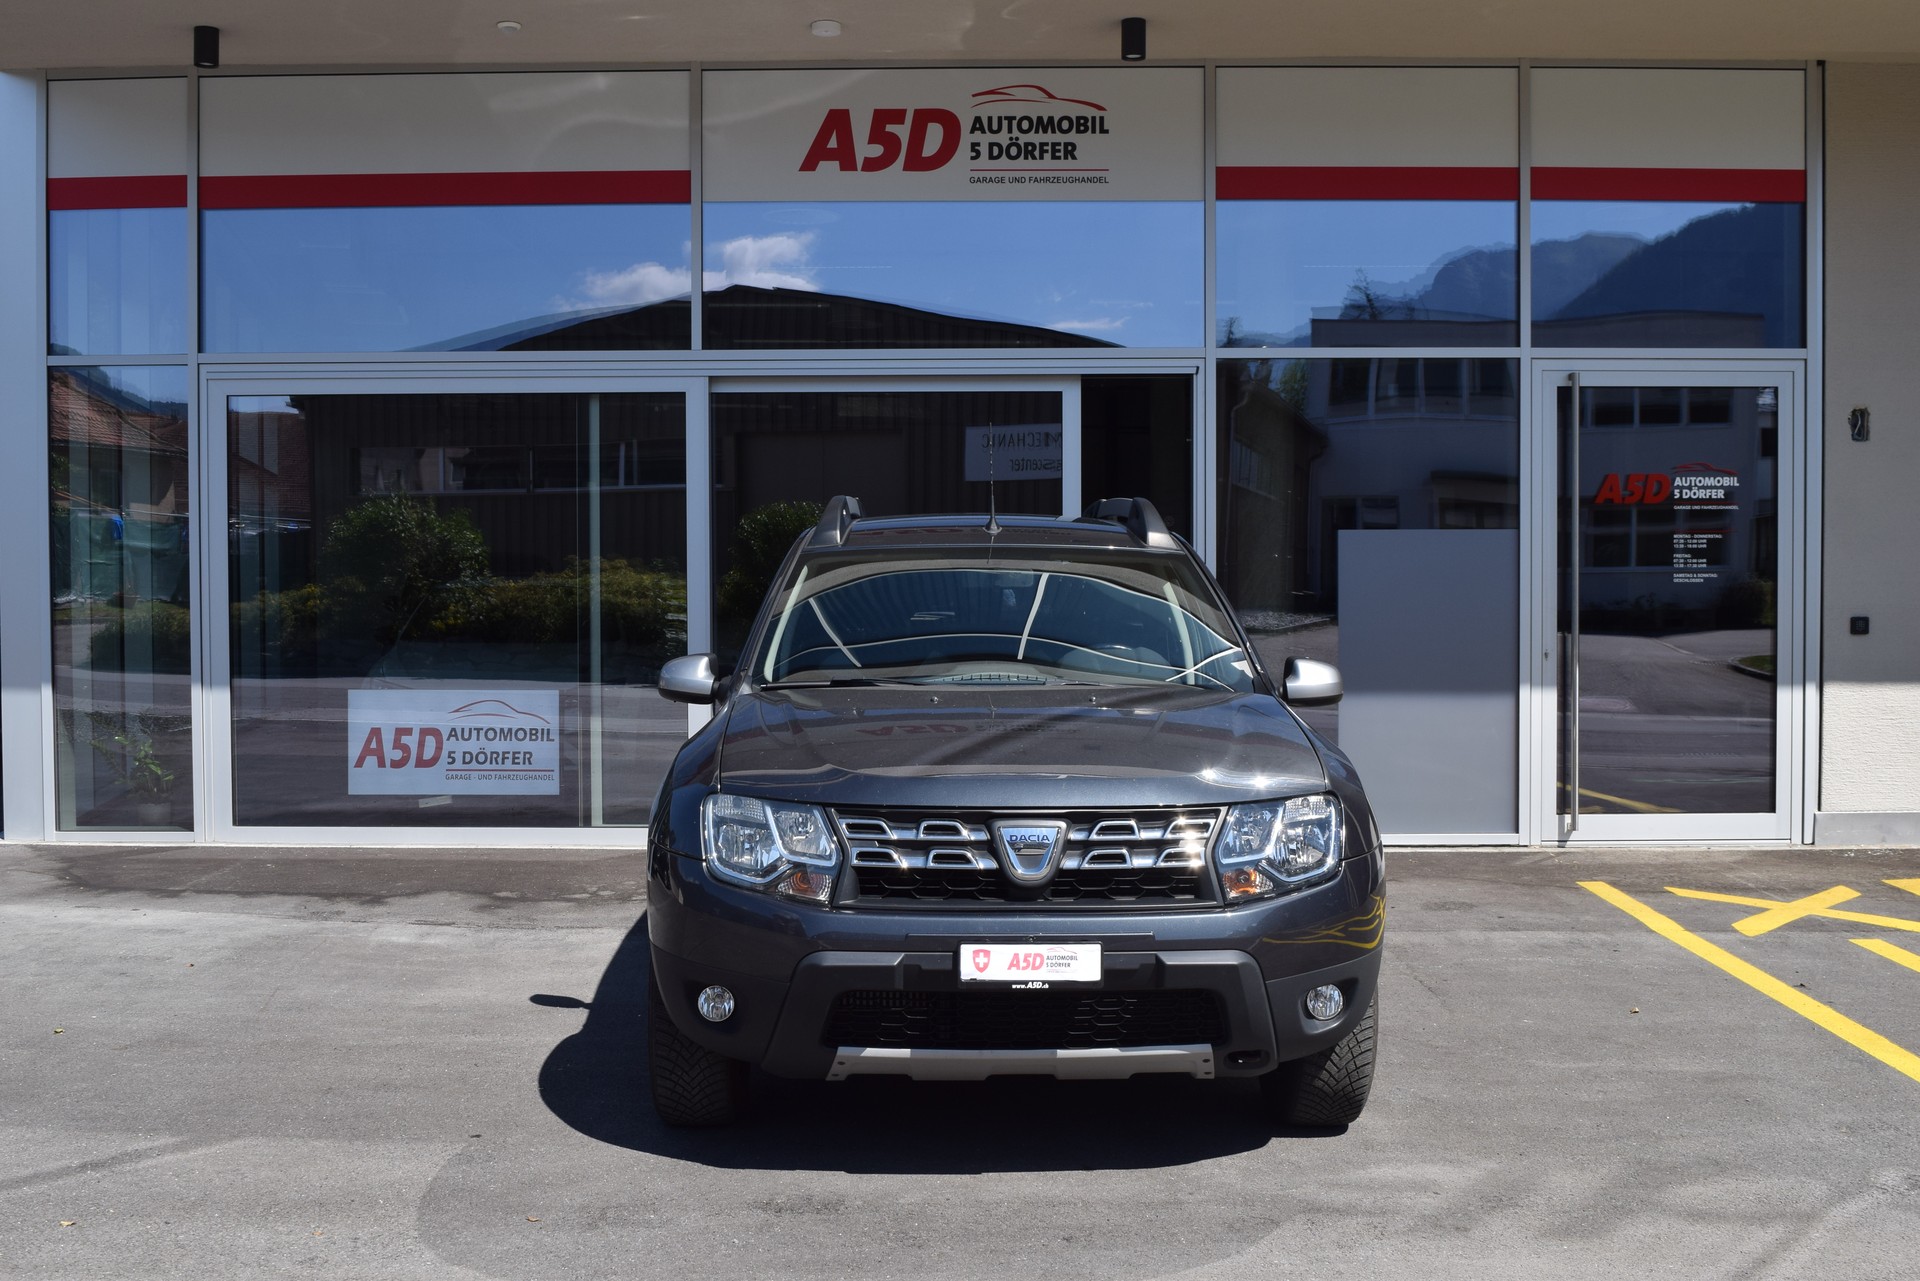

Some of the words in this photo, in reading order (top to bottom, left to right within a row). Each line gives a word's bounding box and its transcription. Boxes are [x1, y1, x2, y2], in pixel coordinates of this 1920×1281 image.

[969, 115, 1109, 135] AUTOMOBIL
[798, 108, 962, 172] A5D
[970, 142, 981, 160] 5
[988, 136, 1078, 160] DÖRFER
[969, 176, 1006, 184] GARAGE
[1008, 176, 1027, 184] UND
[1028, 176, 1109, 184] FAHRZEUGHANDEL
[1595, 473, 1671, 504] A5D
[1674, 477, 1739, 487] AUTOMOBIL
[1674, 489, 1680, 499] 5
[1682, 487, 1725, 499] DÖRFER
[446, 727, 555, 742] AUTOMOBIL
[354, 727, 444, 769] A5D
[447, 751, 456, 765] 5
[462, 748, 533, 765] DÖRFER
[1009, 834, 1050, 842] DACIA
[1007, 953, 1044, 971] A5D
[1012, 981, 1049, 989] www.A5D.ch
